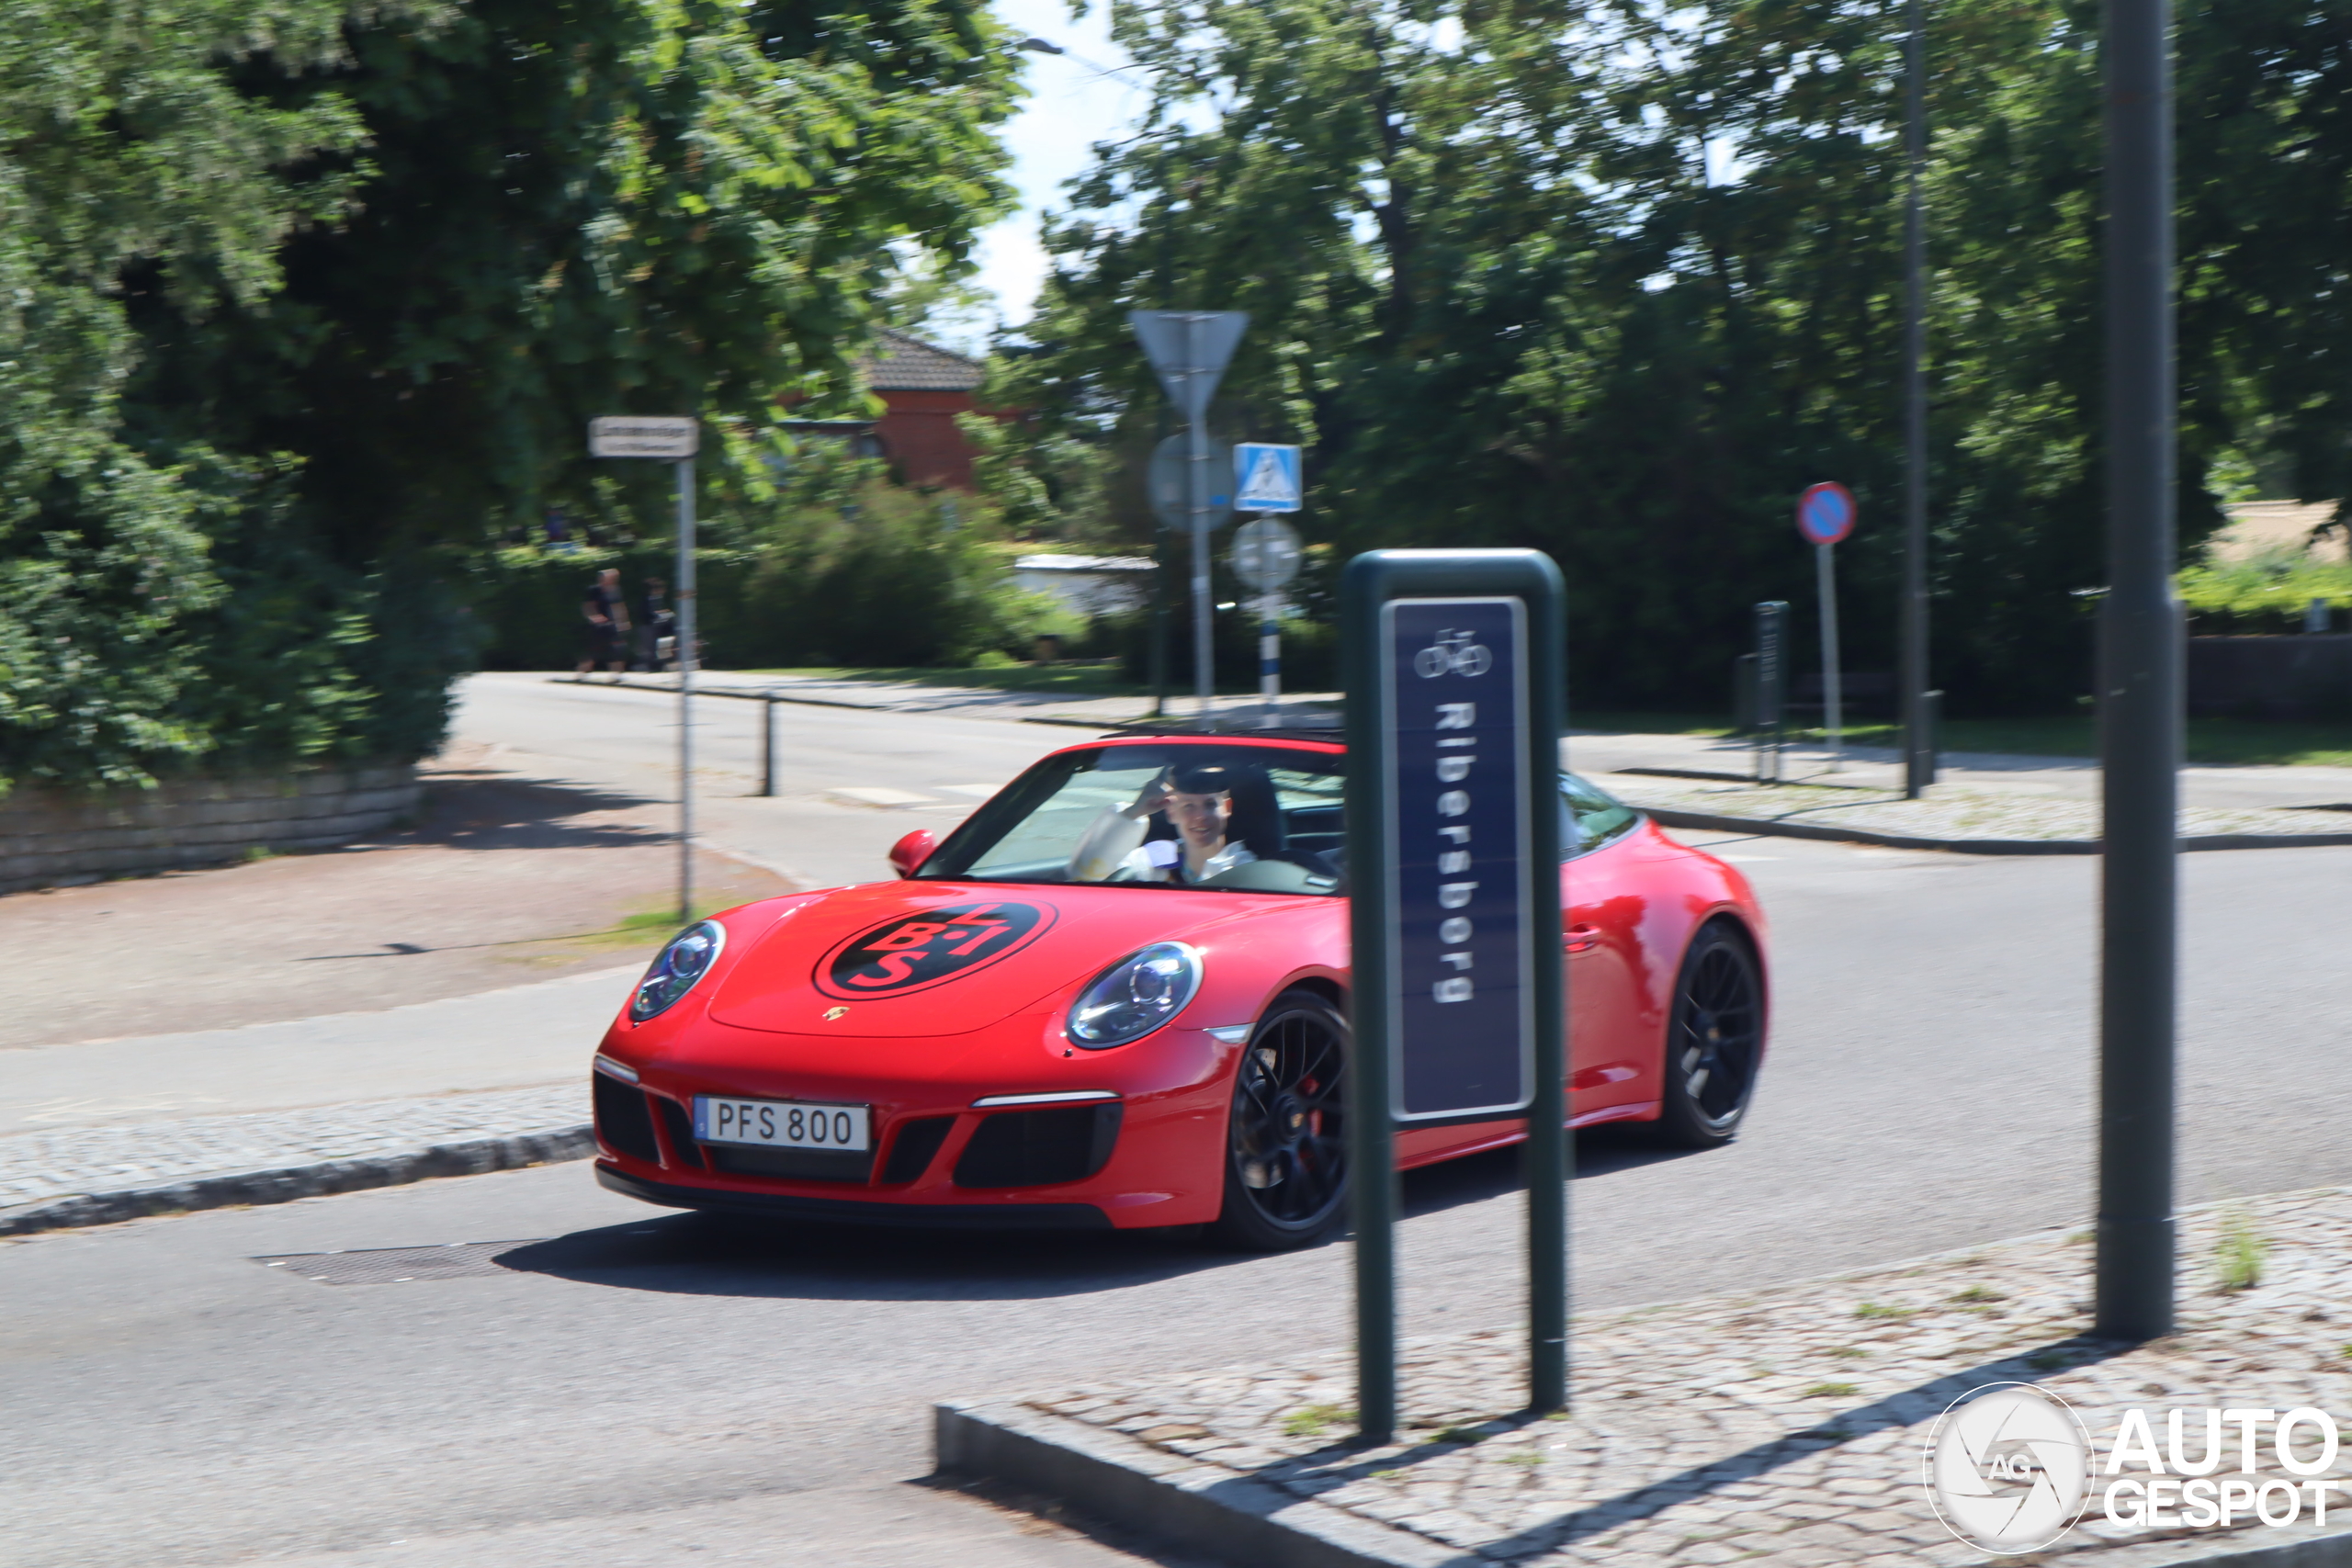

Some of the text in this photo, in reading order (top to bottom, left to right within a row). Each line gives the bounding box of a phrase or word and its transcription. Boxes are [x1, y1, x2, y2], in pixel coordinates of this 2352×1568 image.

[1432, 702, 1479, 1003] Ribersborg
[718, 1103, 852, 1145] PFS 800
